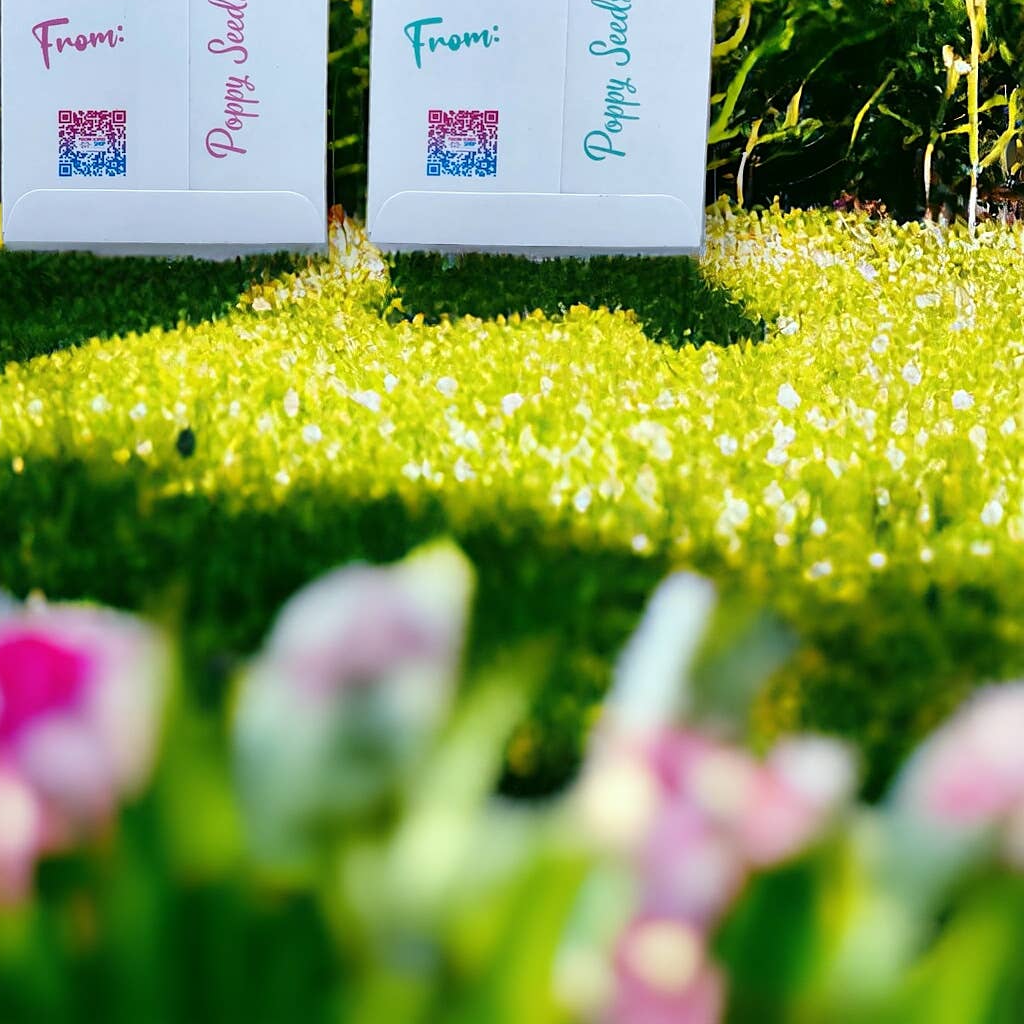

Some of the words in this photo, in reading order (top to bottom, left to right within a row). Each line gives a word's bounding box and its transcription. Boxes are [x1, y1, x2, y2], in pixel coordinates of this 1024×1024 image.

[31, 17, 125, 71] From:
[403, 16, 501, 70] From:
[206, 74, 261, 159] Poppy
[583, 77, 641, 162] Poppy
